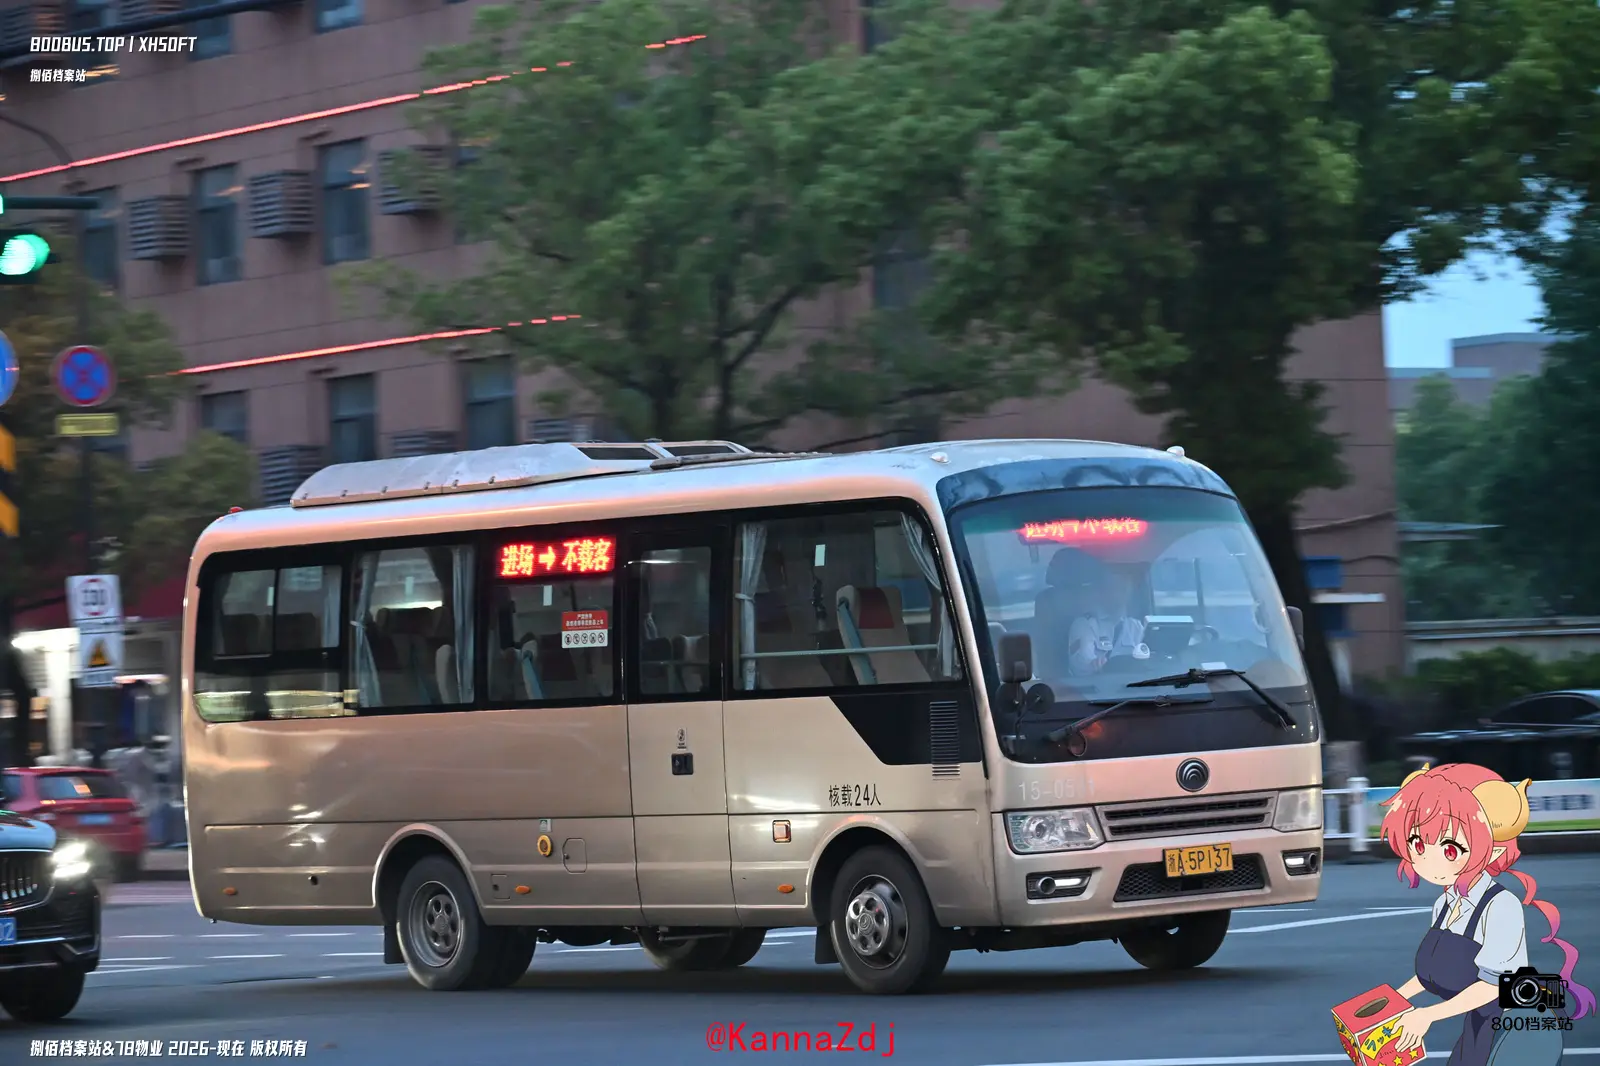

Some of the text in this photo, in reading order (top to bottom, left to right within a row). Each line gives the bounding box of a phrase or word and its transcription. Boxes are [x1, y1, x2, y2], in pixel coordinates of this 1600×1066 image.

[501, 537, 612, 576] 进场 不载客
[829, 783, 882, 807] 核载24人
